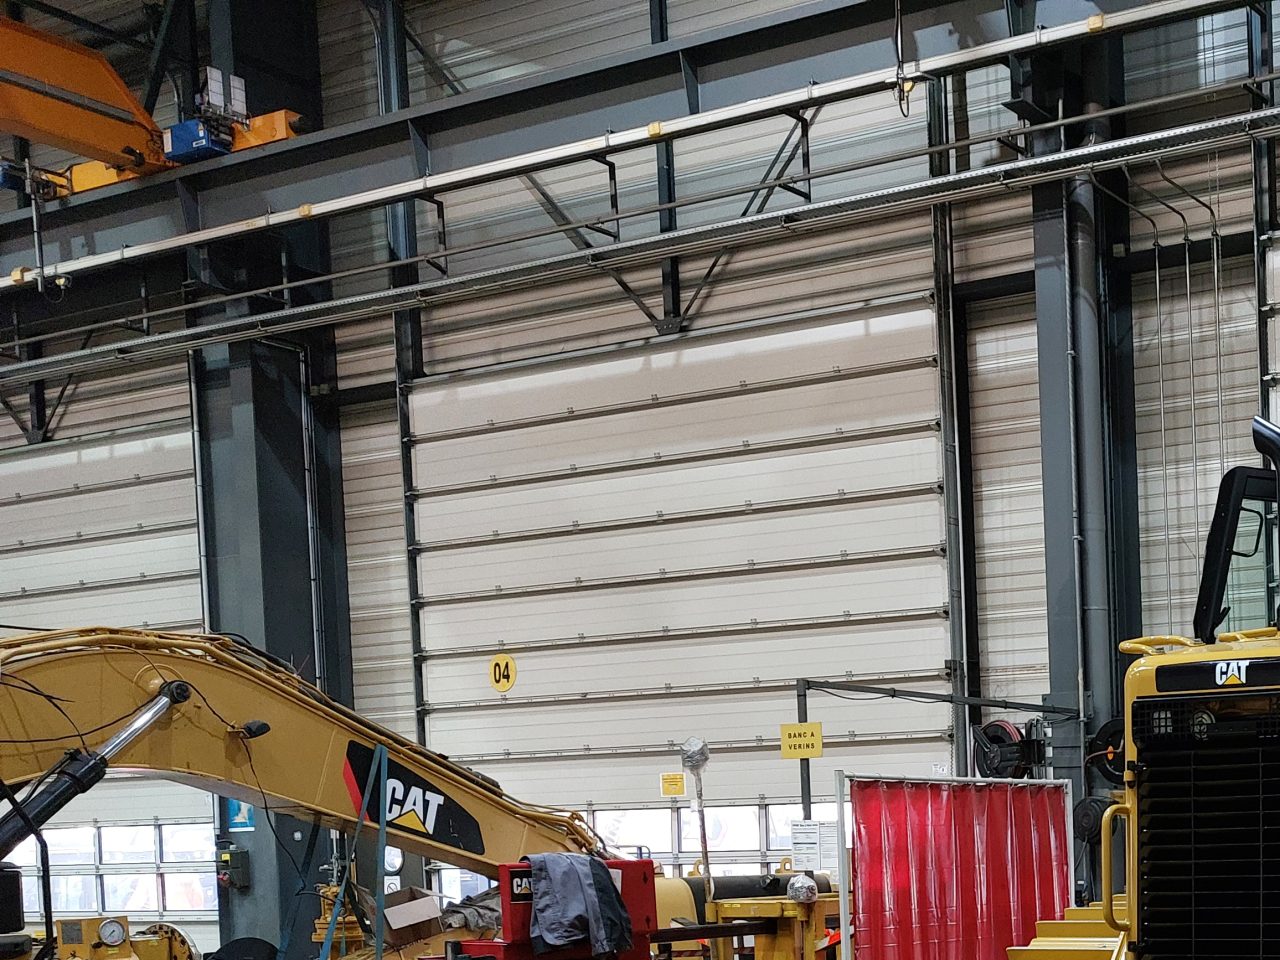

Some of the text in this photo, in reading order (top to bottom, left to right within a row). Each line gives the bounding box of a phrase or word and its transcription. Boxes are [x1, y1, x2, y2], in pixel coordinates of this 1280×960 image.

[493, 661, 511, 684] 04
[1215, 660, 1250, 686] CAT
[787, 731, 808, 739] BANC
[788, 742, 816, 750] VERINS
[385, 778, 445, 835] CAT
